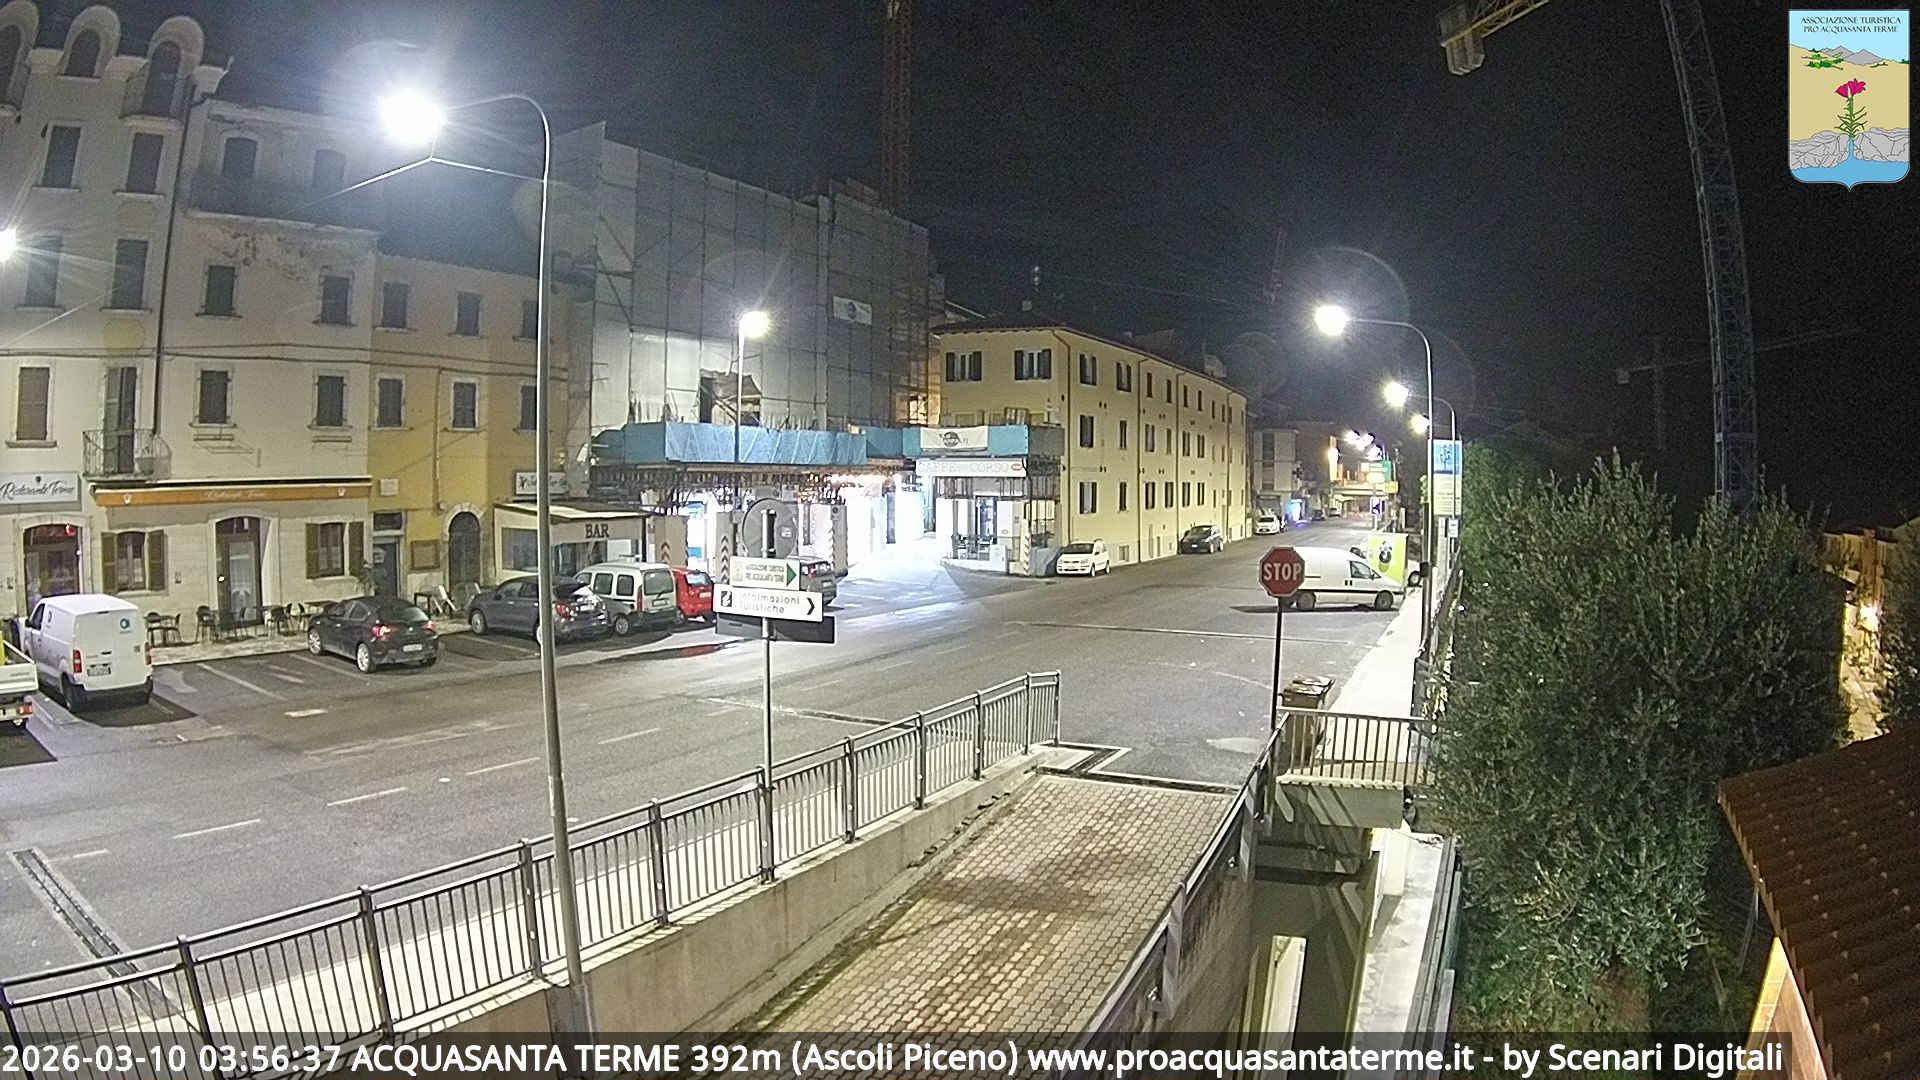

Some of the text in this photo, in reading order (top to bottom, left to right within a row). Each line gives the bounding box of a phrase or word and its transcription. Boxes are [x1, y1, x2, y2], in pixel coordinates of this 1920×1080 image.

[969, 462, 1009, 473] CORSO
[585, 523, 610, 539] BAR
[1263, 562, 1302, 581] STOP
